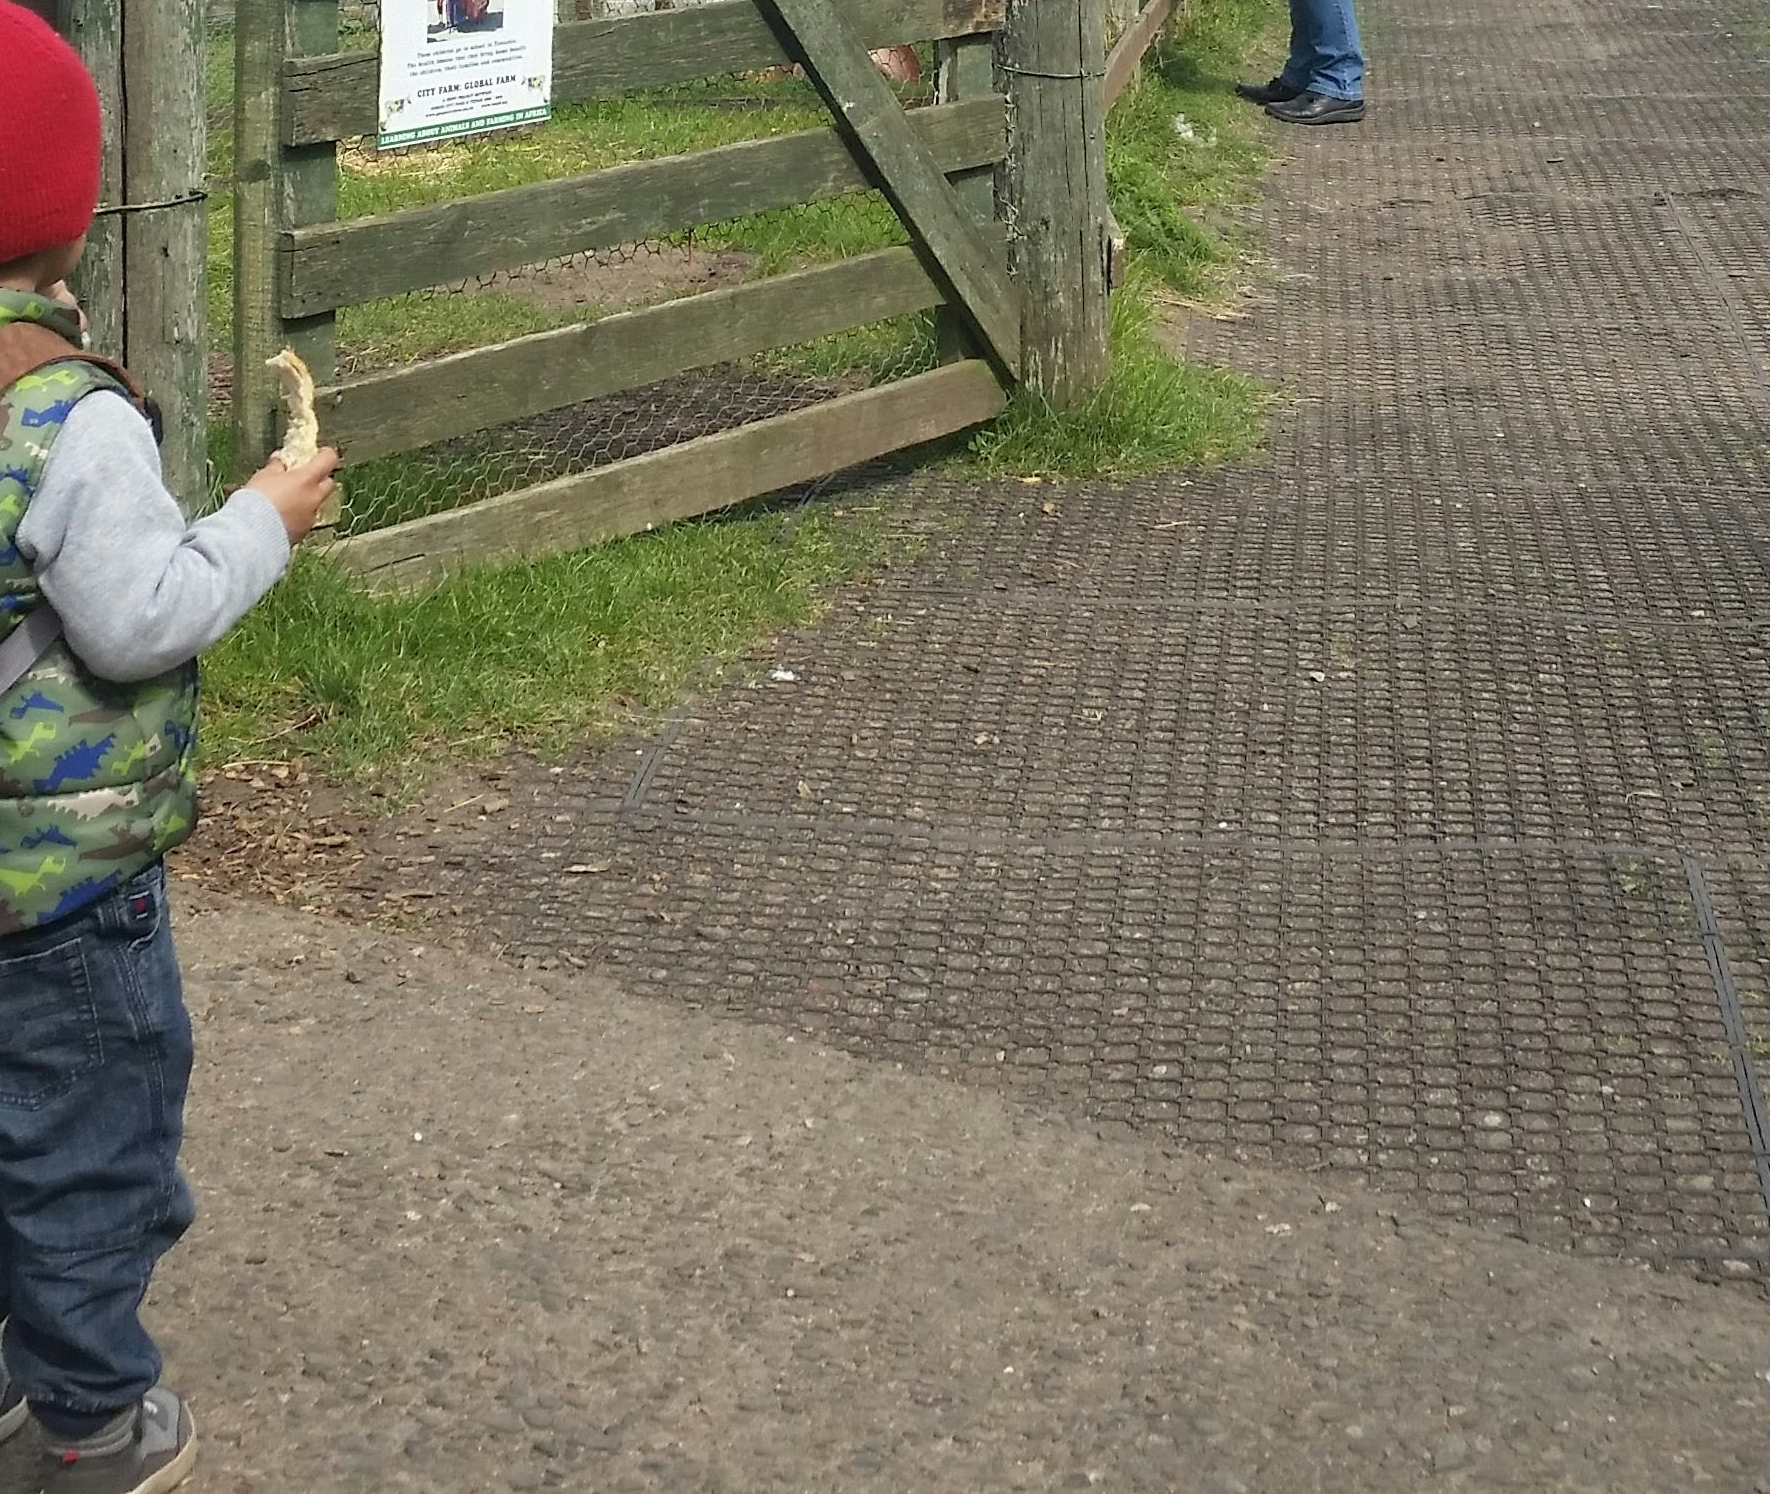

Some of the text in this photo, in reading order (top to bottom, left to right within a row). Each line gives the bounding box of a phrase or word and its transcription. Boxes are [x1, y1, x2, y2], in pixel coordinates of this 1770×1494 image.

[417, 87, 437, 98] CITY
[464, 78, 494, 91] GLOBAL
[496, 74, 516, 85] FARM
[380, 107, 547, 145] LEARNING ABOUT ANIMALS AND FARMING IN AFRICA
